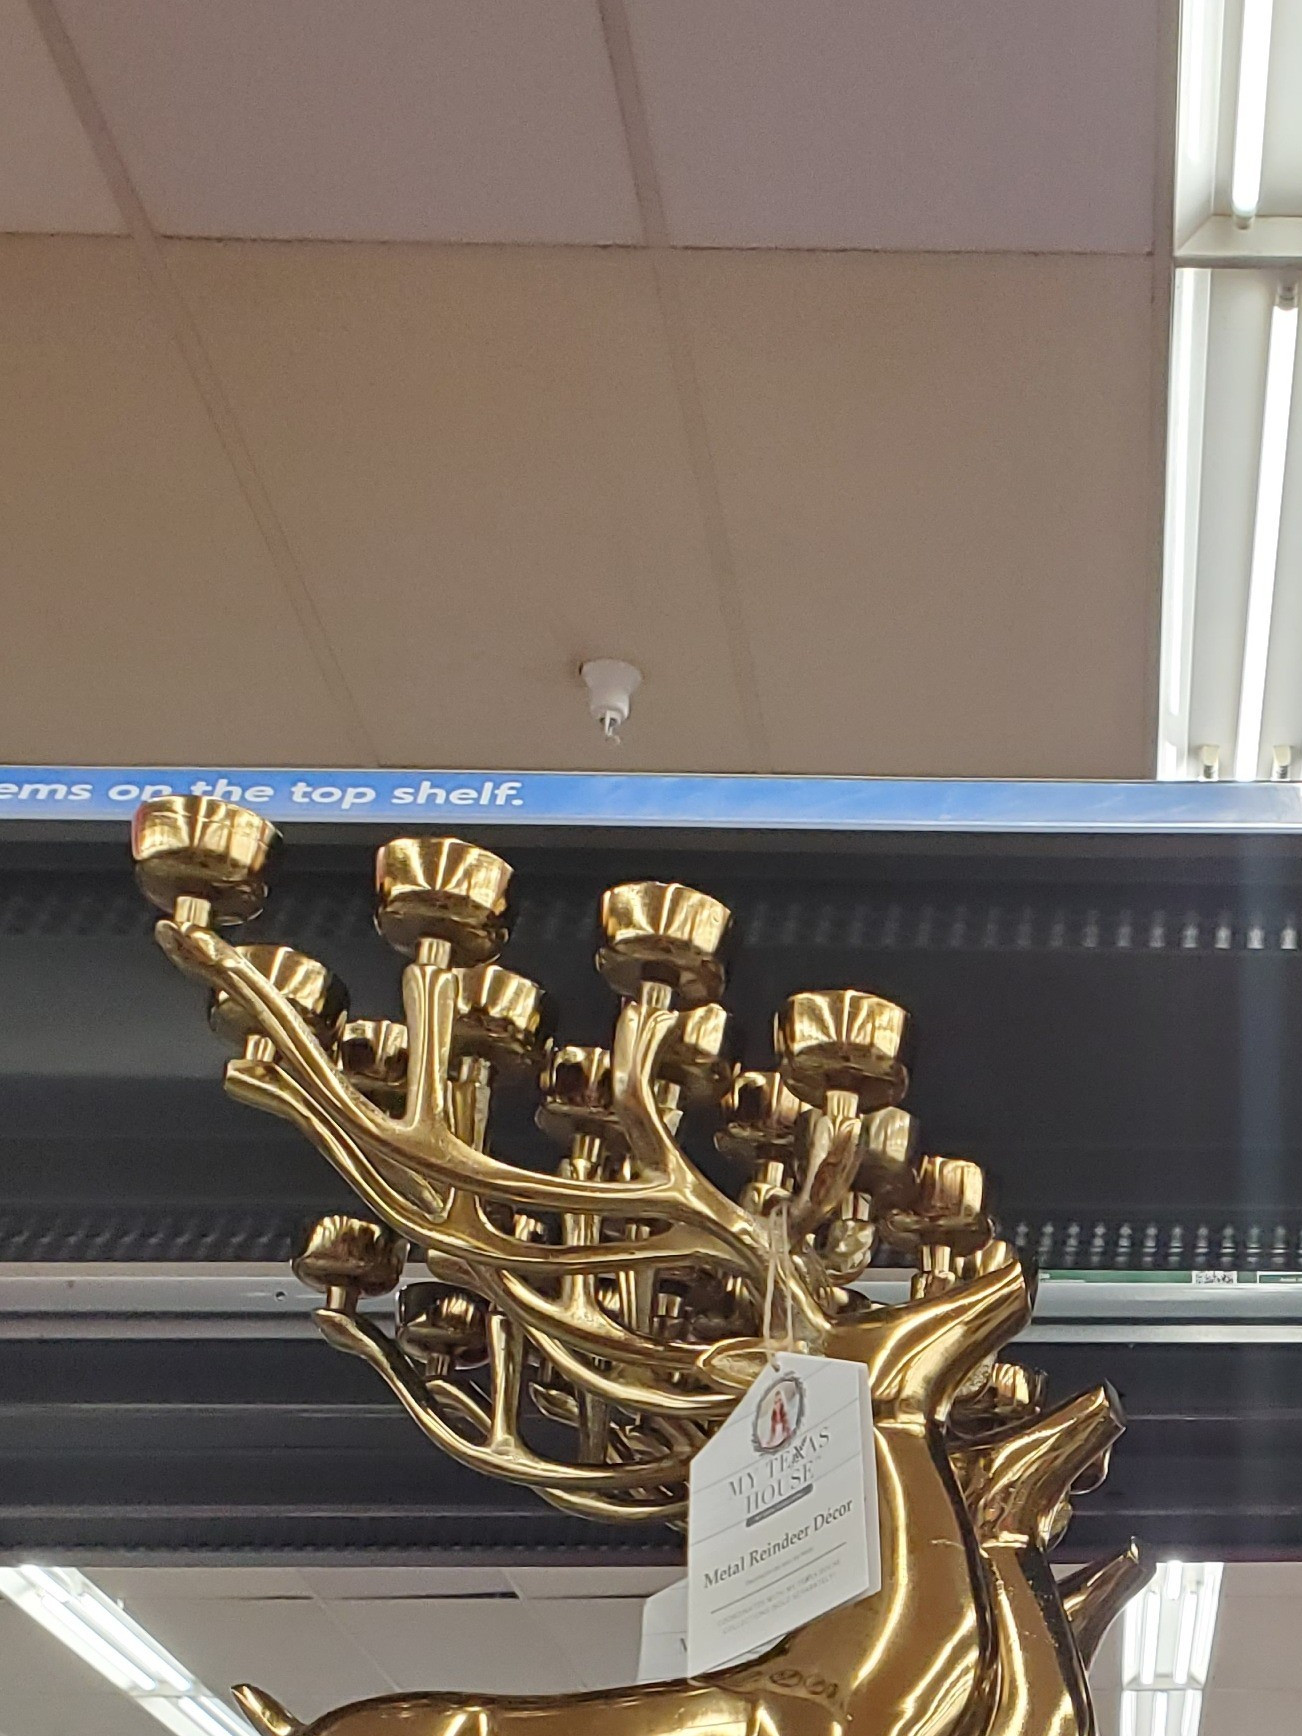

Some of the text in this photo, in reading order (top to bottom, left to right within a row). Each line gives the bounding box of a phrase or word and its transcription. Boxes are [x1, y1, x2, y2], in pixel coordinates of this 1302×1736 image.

[190, 778, 275, 802] the
[291, 780, 376, 809] top
[391, 780, 525, 806] shelf.
[730, 1427, 830, 1497] MY TEXAS
[745, 1461, 815, 1514] HOUSE
[703, 1556, 745, 1589] Metal
[749, 1526, 811, 1567] Reindeer
[814, 1499, 854, 1533] Décor
